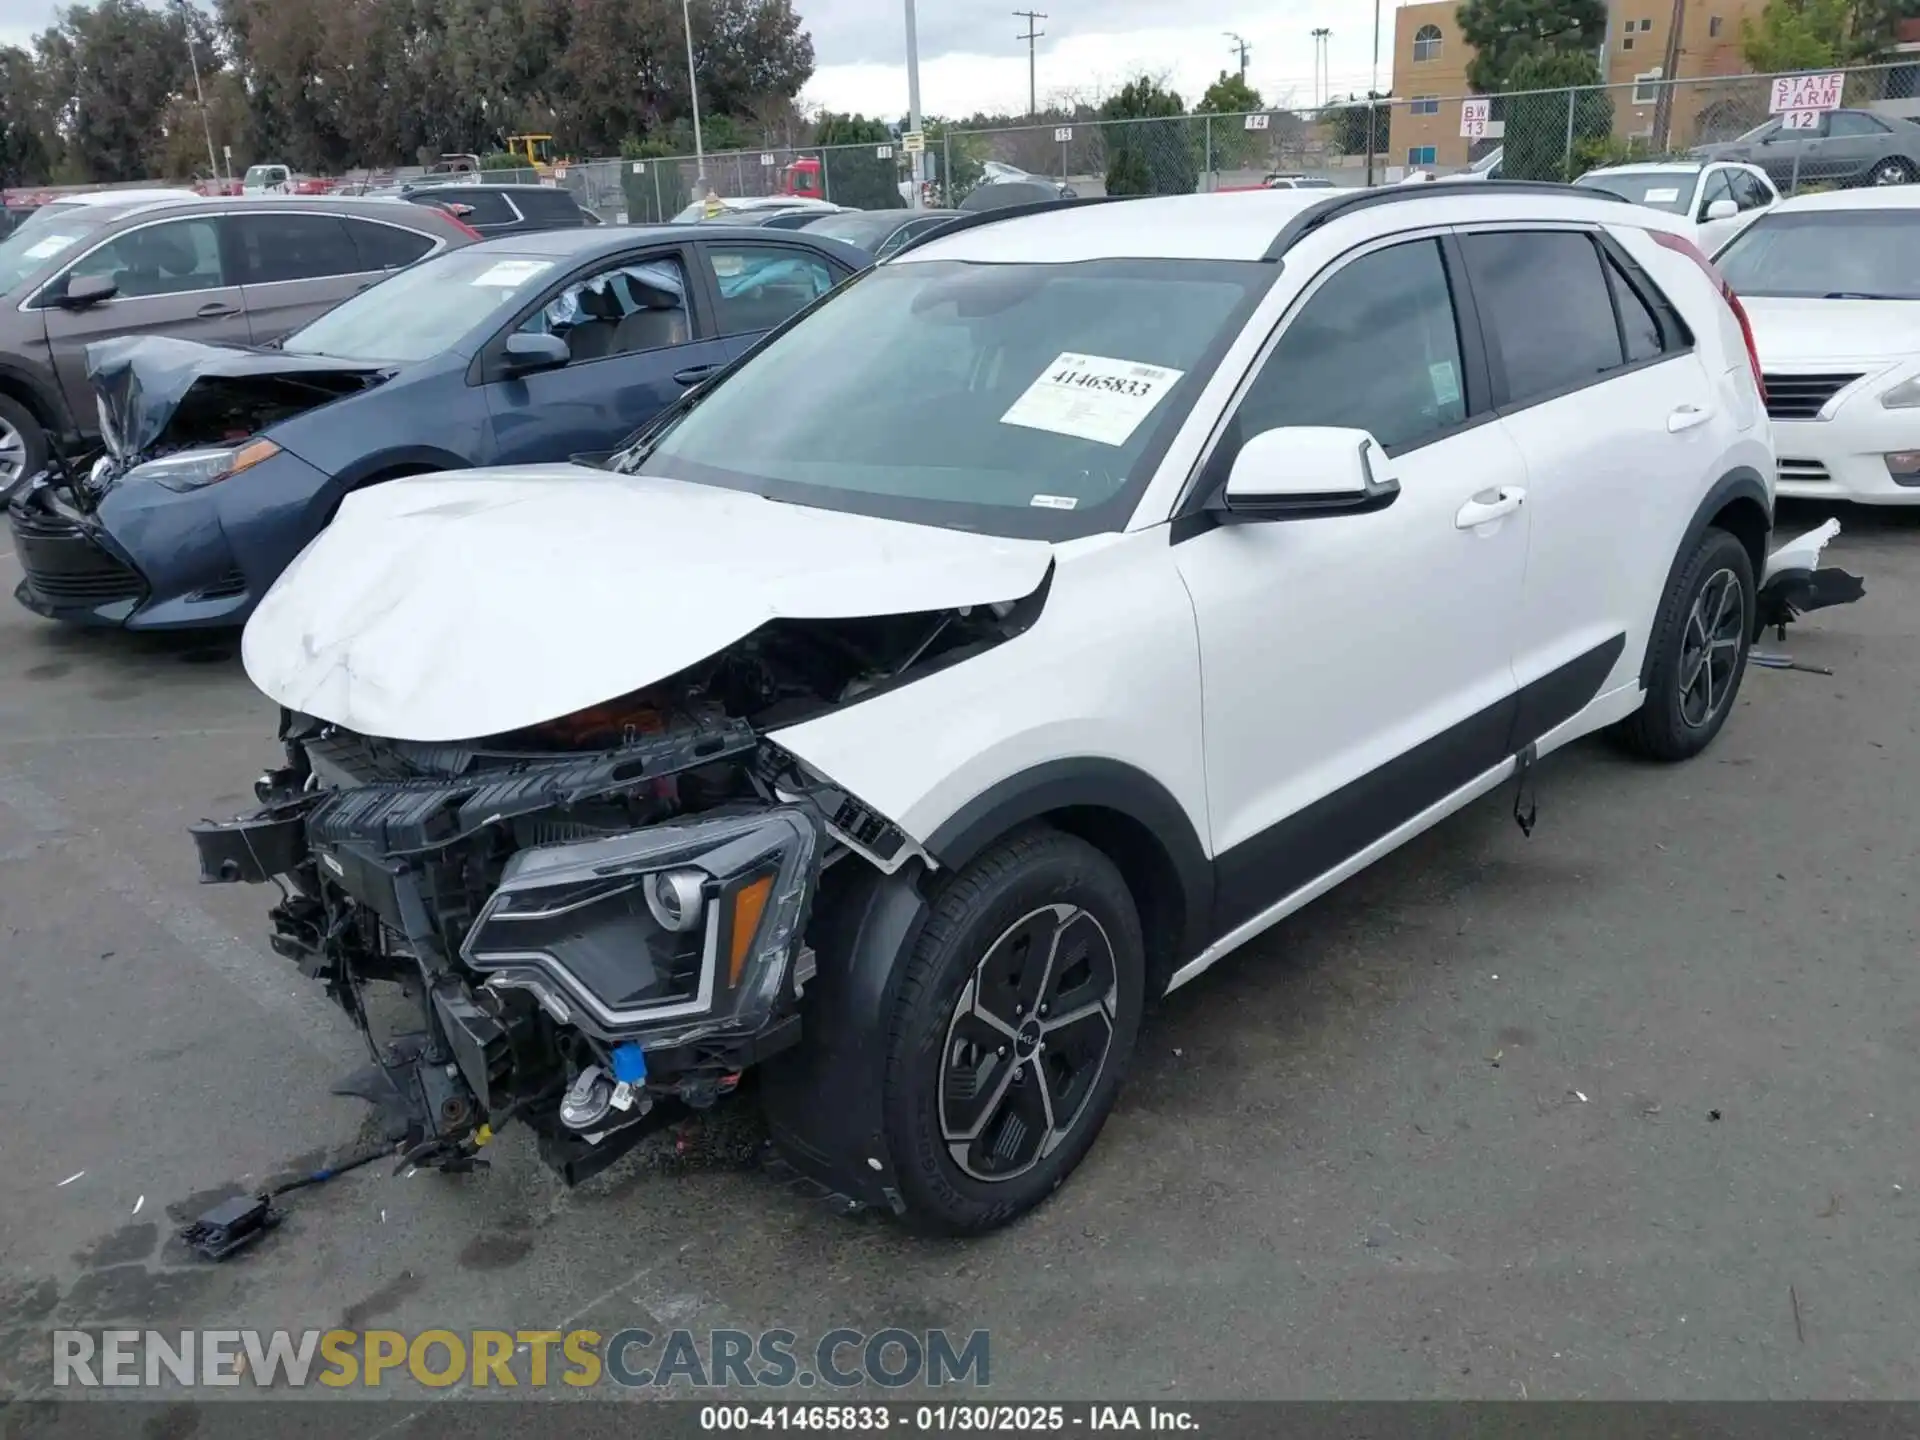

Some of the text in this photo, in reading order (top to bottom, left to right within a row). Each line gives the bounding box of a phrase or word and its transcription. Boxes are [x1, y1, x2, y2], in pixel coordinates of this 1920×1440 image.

[1777, 75, 1841, 93] STATE
[1778, 89, 1836, 107] FARM
[1464, 106, 1486, 118] BW
[1790, 112, 1813, 128] 12
[1466, 122, 1484, 136] 13
[1052, 370, 1152, 397] 41465833
